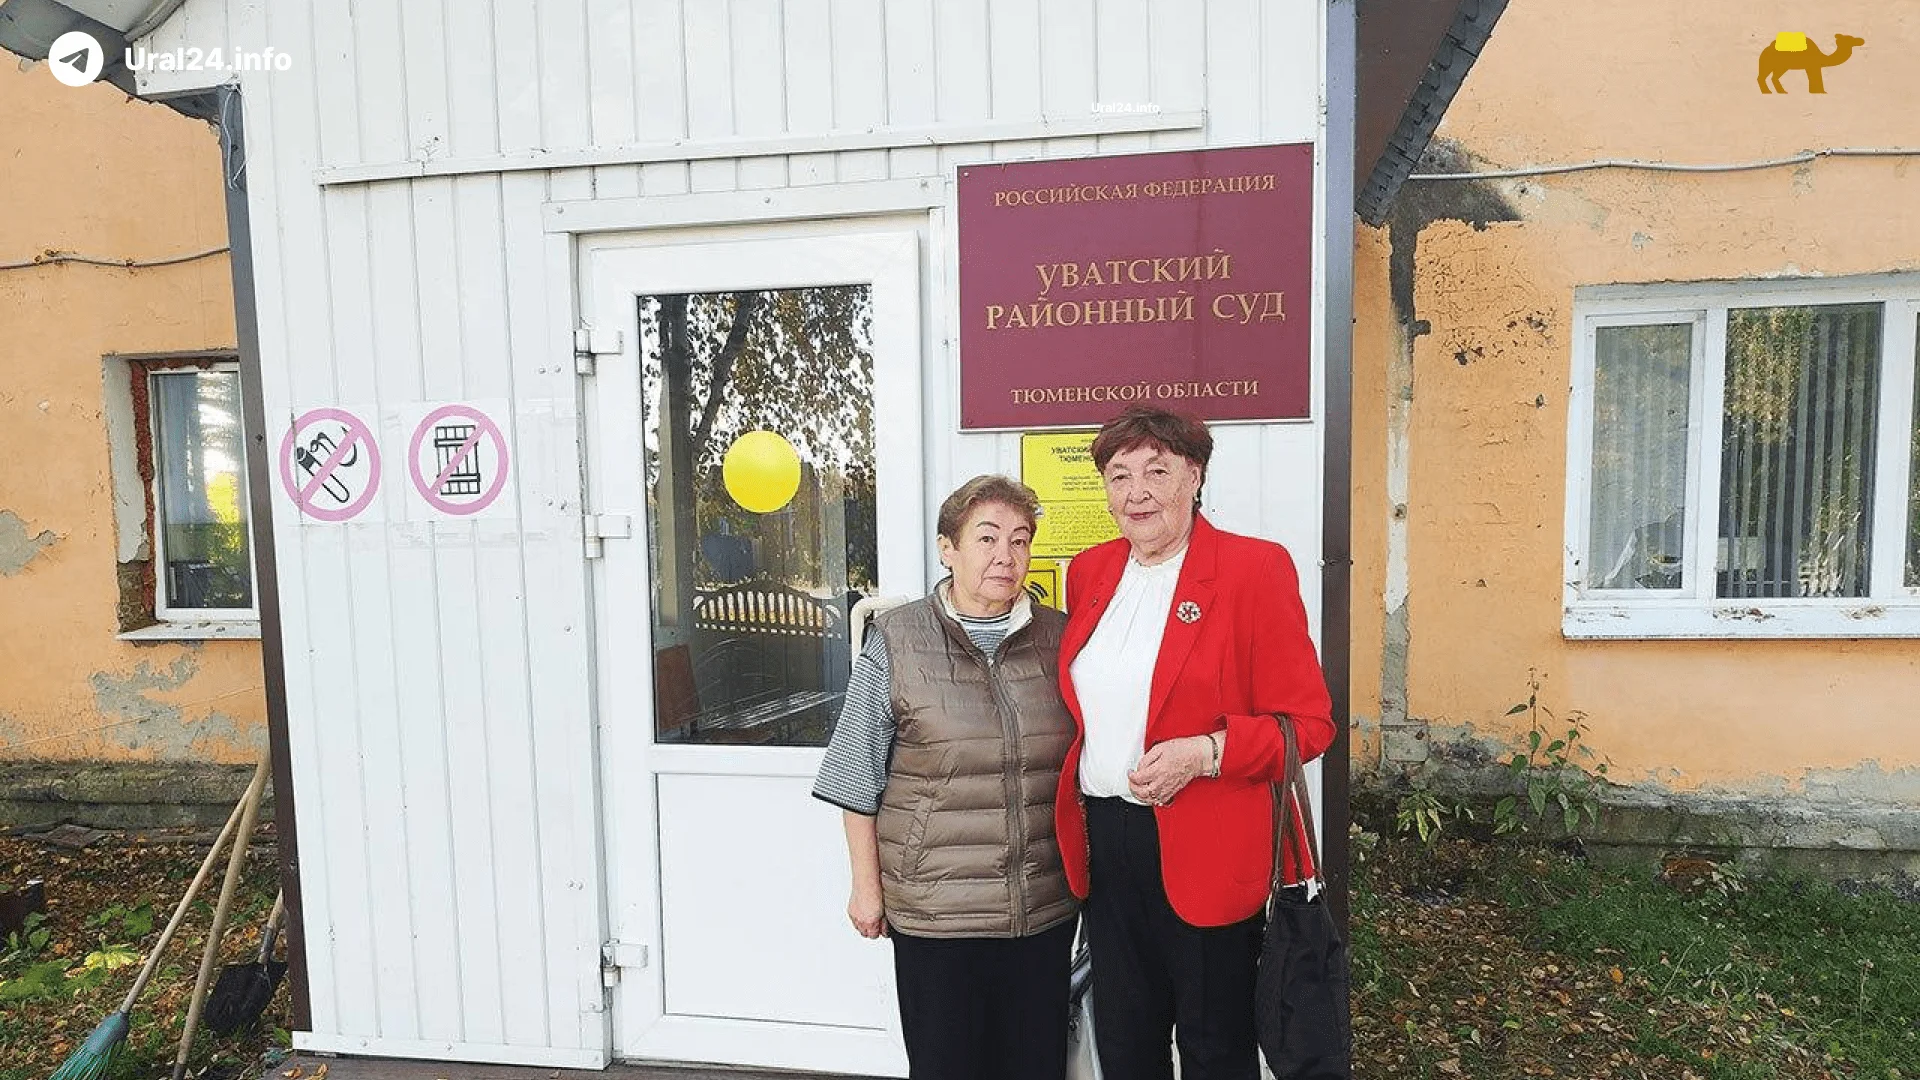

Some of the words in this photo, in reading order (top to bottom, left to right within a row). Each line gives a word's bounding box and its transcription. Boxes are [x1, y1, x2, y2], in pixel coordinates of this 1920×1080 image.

[994, 183, 1138, 207] РОССИЙСКАЯ
[1144, 174, 1277, 199] ФЕДЕРАЦИЯ
[1035, 248, 1232, 296] УВАТСКИЙ
[985, 290, 1195, 330] РАЙОННЫЙ
[1212, 292, 1286, 324] СУД
[1010, 381, 1151, 404] ТЮМЕНСКОЙ
[1156, 380, 1259, 399] ОБЛАСТИ
